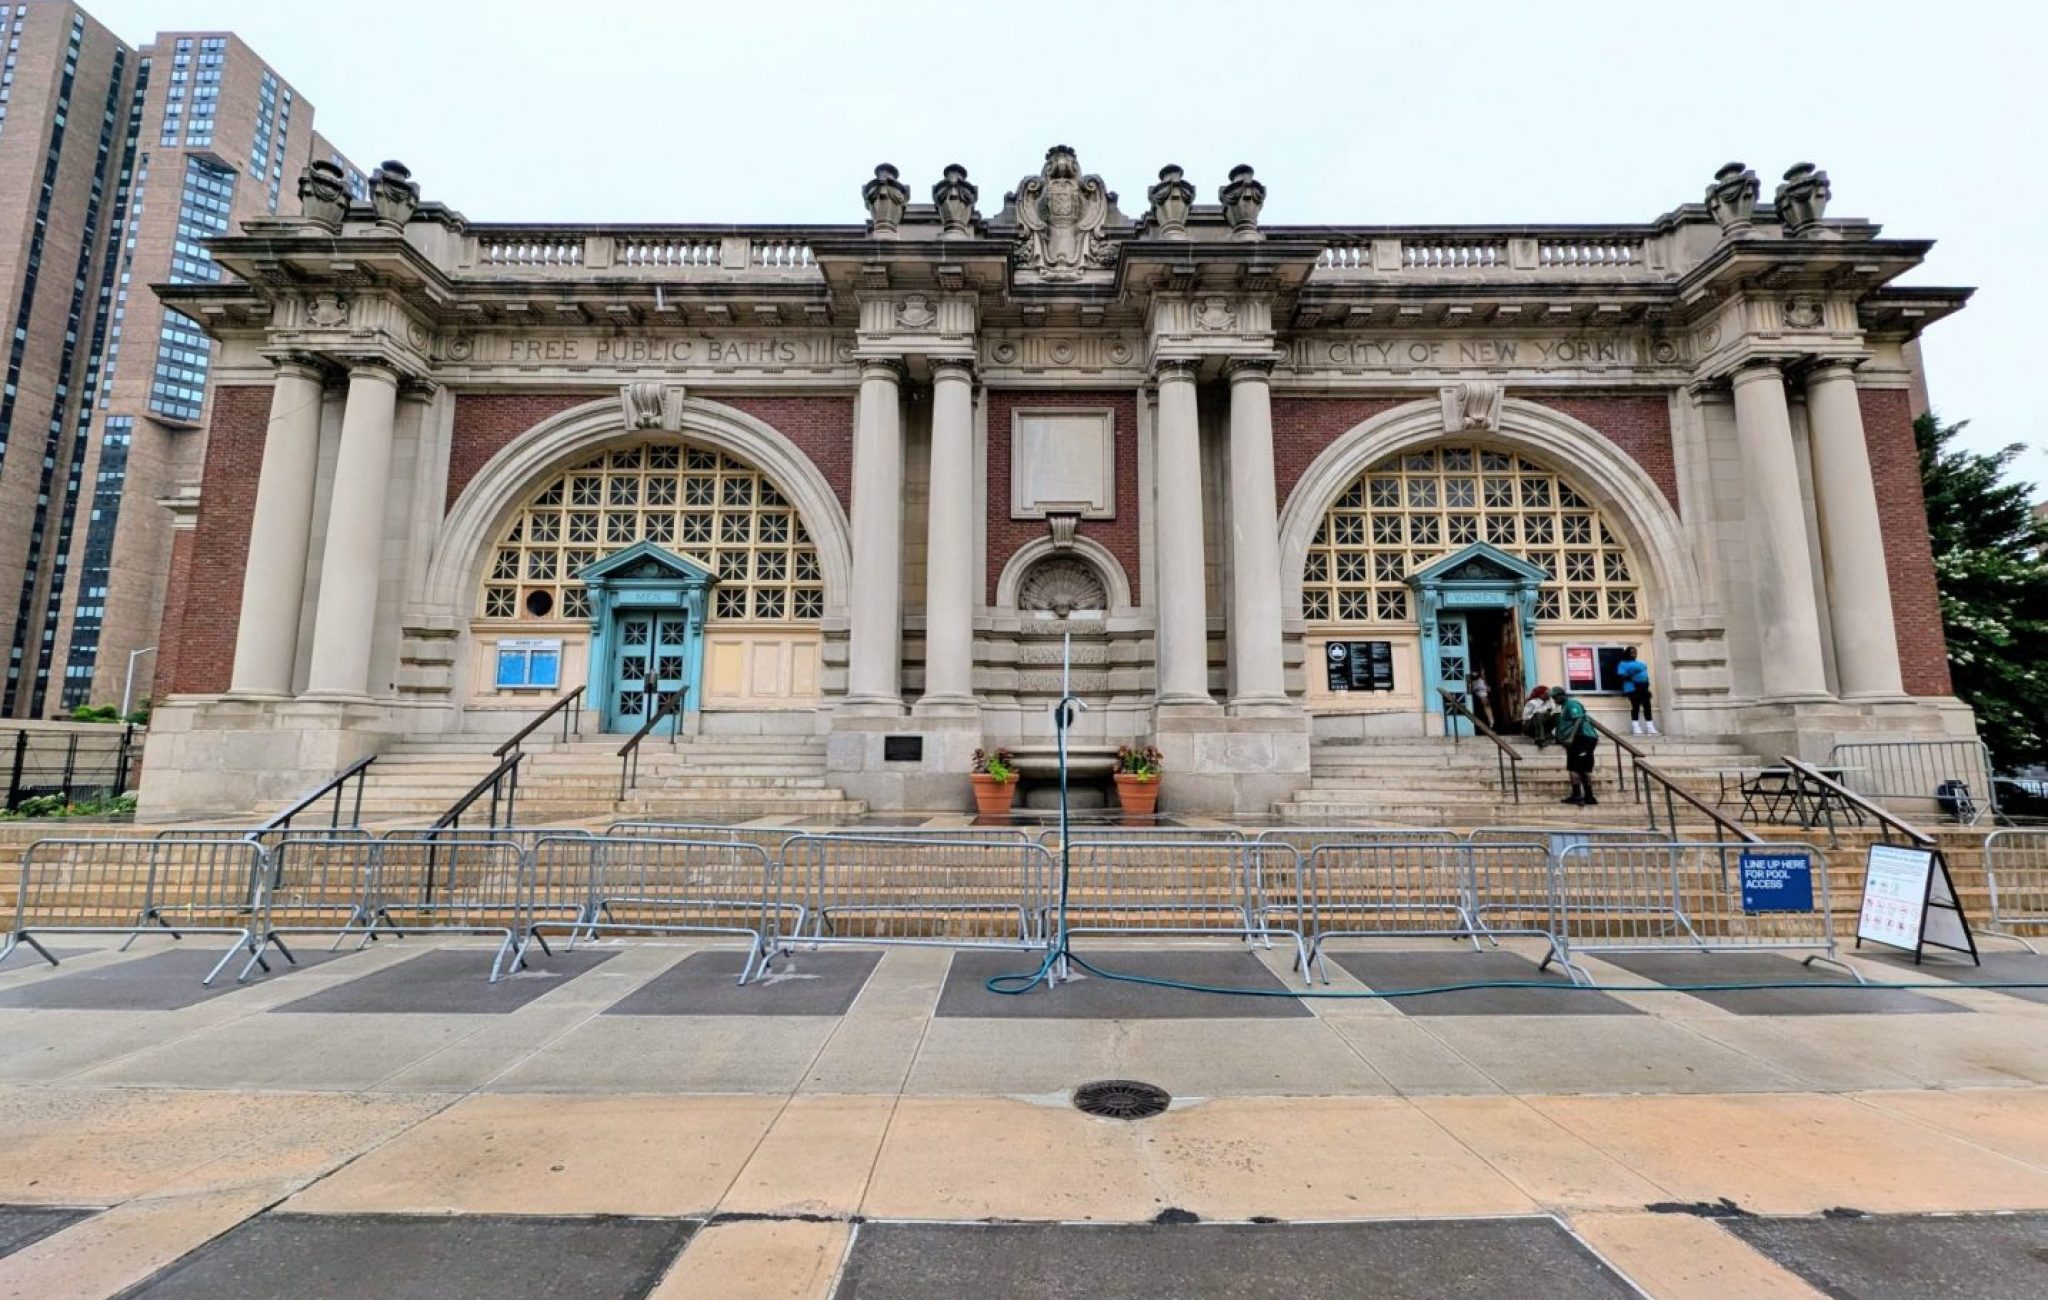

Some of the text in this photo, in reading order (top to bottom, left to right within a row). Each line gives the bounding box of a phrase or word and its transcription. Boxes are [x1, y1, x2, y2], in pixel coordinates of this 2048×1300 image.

[509, 339, 796, 362] FREE PUBLIC BATHS
[1329, 341, 1616, 363] CITY OF NEW YORK
[1454, 592, 1499, 602] WOMEN
[1744, 859, 1807, 870] LINE UP HERE
[1744, 869, 1791, 880] FOR POOL
[1745, 879, 1783, 890] ACCESS
